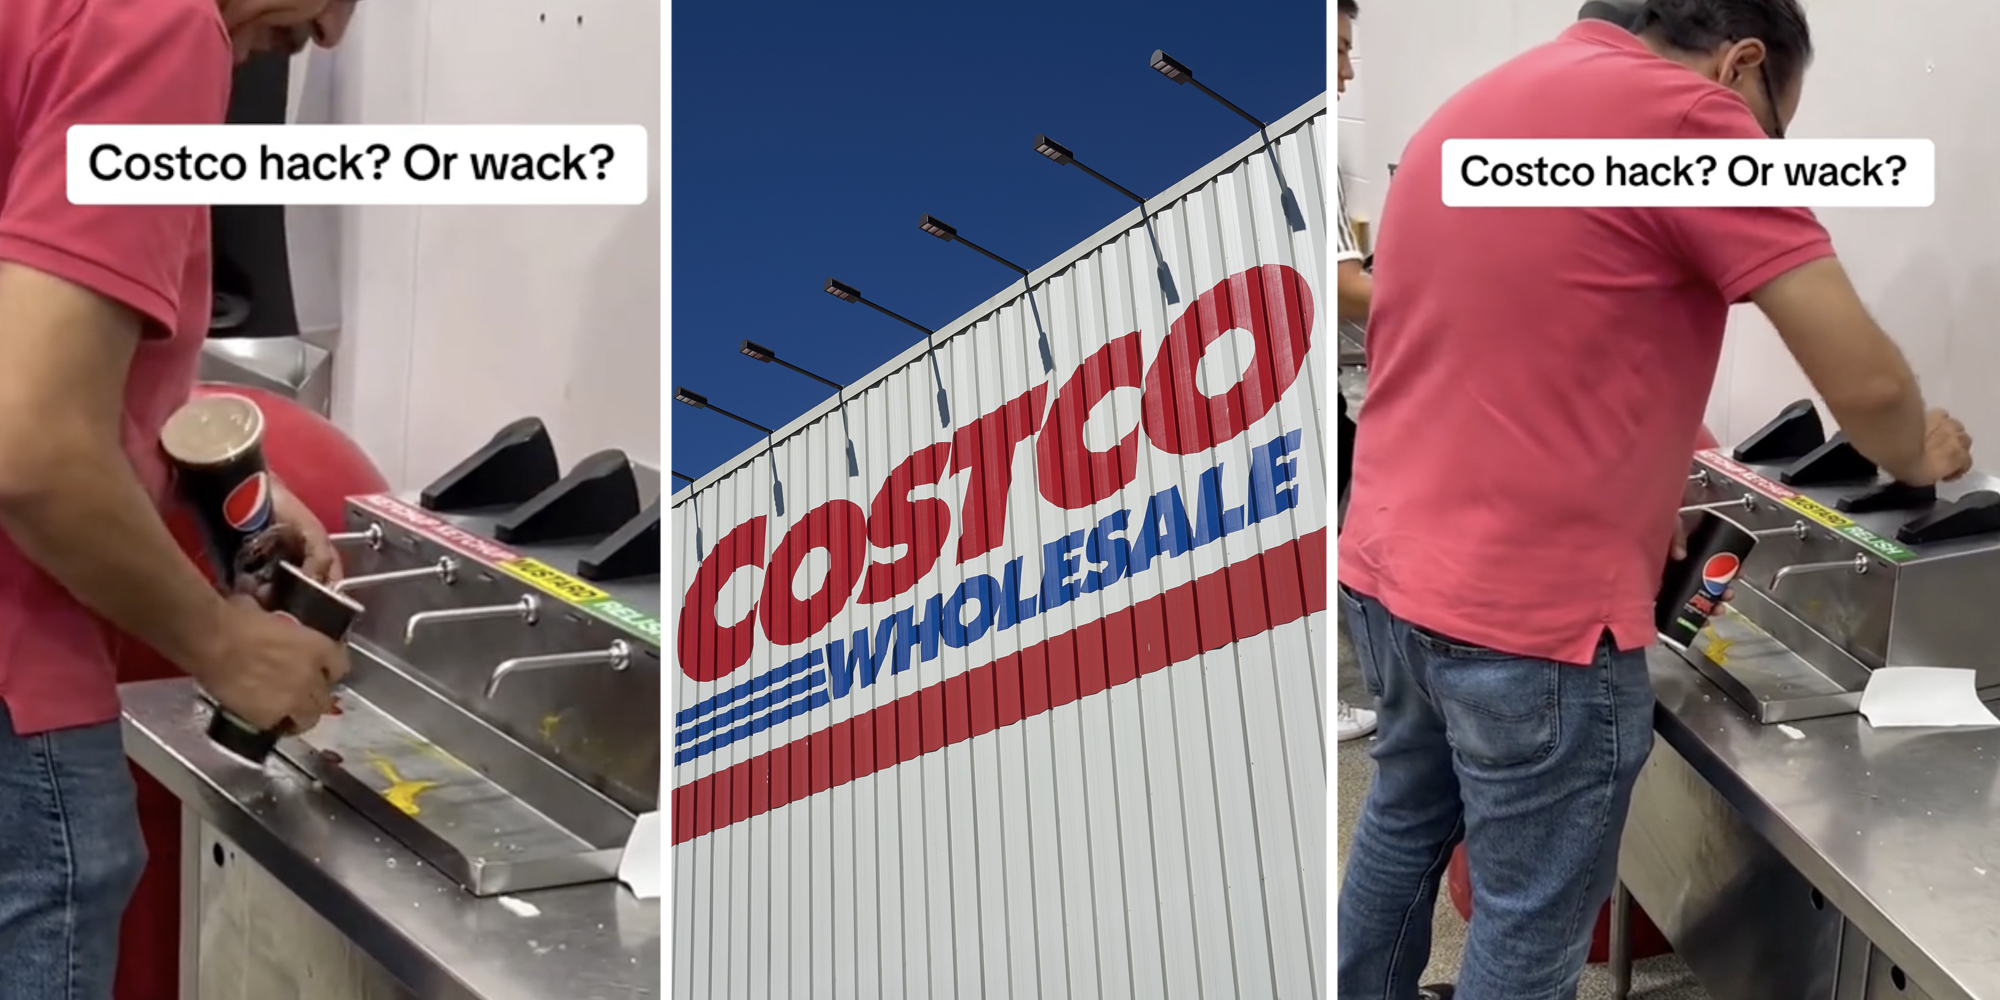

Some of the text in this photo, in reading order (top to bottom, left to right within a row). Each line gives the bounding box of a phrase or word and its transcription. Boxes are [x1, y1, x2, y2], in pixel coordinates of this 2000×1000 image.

[677, 263, 1315, 683] COSTCO
[1741, 471, 1797, 498] KETCHUP
[367, 494, 442, 526] KETCHUP
[1792, 497, 1848, 525] MUSTARD
[434, 523, 519, 561] KETCHUP
[1843, 525, 1904, 555] RELISH
[516, 558, 598, 598] MUSTARD
[825, 427, 1303, 701] WHOLESALE
